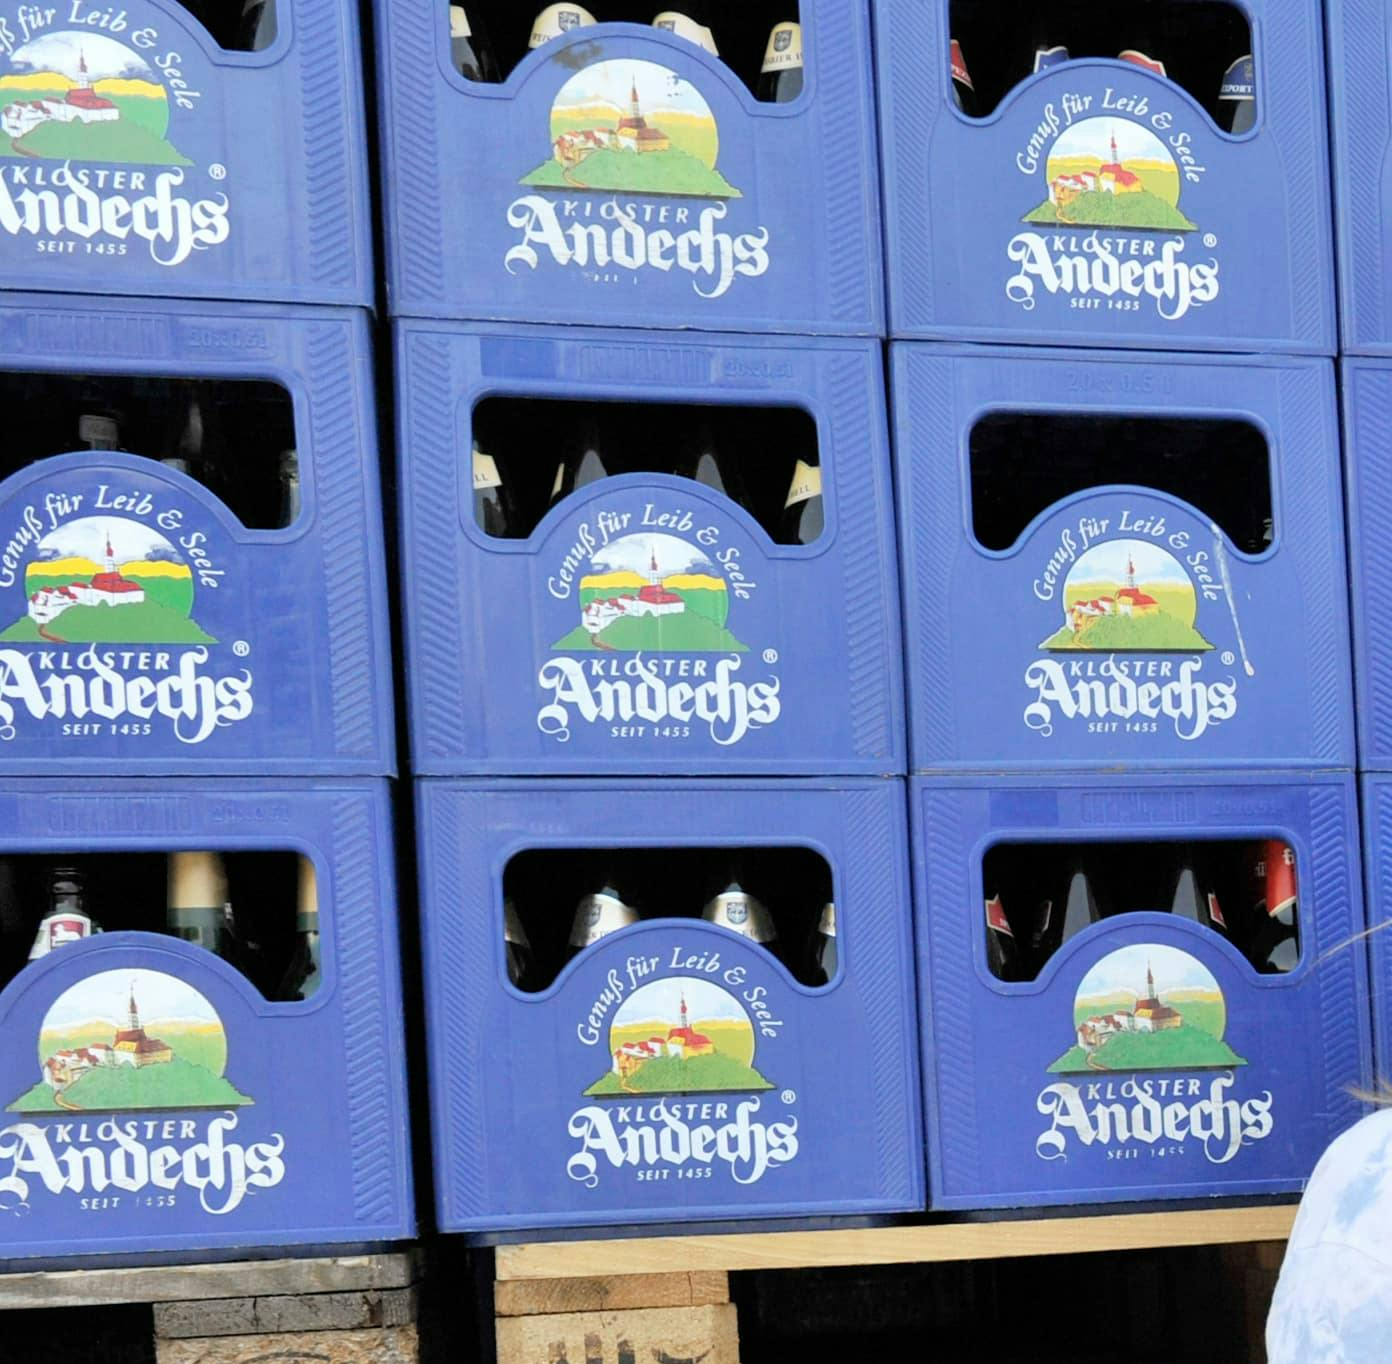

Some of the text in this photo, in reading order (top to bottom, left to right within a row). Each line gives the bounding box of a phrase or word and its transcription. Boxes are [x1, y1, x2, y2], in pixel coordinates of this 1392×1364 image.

[13, 165, 146, 190] KLOSTER
[1063, 92, 1093, 125] für
[1102, 87, 1149, 117] Leib
[1169, 134, 1202, 185] Seele
[505, 194, 769, 298] Andechs
[1006, 230, 1218, 319] Andechs
[1053, 236, 1155, 256] KLOSTER
[1071, 298, 1139, 310] SEIT 1455
[45, 493, 84, 529] für
[95, 485, 153, 515] Leib
[181, 532, 225, 588] Seele
[598, 511, 631, 545] für
[641, 504, 694, 532] Leib
[717, 547, 755, 599] Seele
[0, 643, 253, 743] Andechs
[39, 652, 170, 670] KLOSTER
[537, 651, 780, 745] Andechs
[591, 660, 708, 676] KLOSTER
[1024, 653, 1236, 739] Andechs
[1071, 661, 1172, 676] KLOSTER
[611, 727, 689, 737] SEIT 1455
[627, 956, 659, 991] für
[669, 946, 722, 974] Leib
[743, 988, 779, 1041] Seele
[57, 1120, 197, 1143] KLOSTER
[618, 1103, 728, 1123] KLOSTER
[1036, 1070, 1273, 1167] Andechs
[1088, 1079, 1202, 1100] KLOSTER
[0, 1111, 285, 1218] Andechs
[567, 1095, 798, 1188] Andechs
[637, 1168, 712, 1180] SEIT 1455
